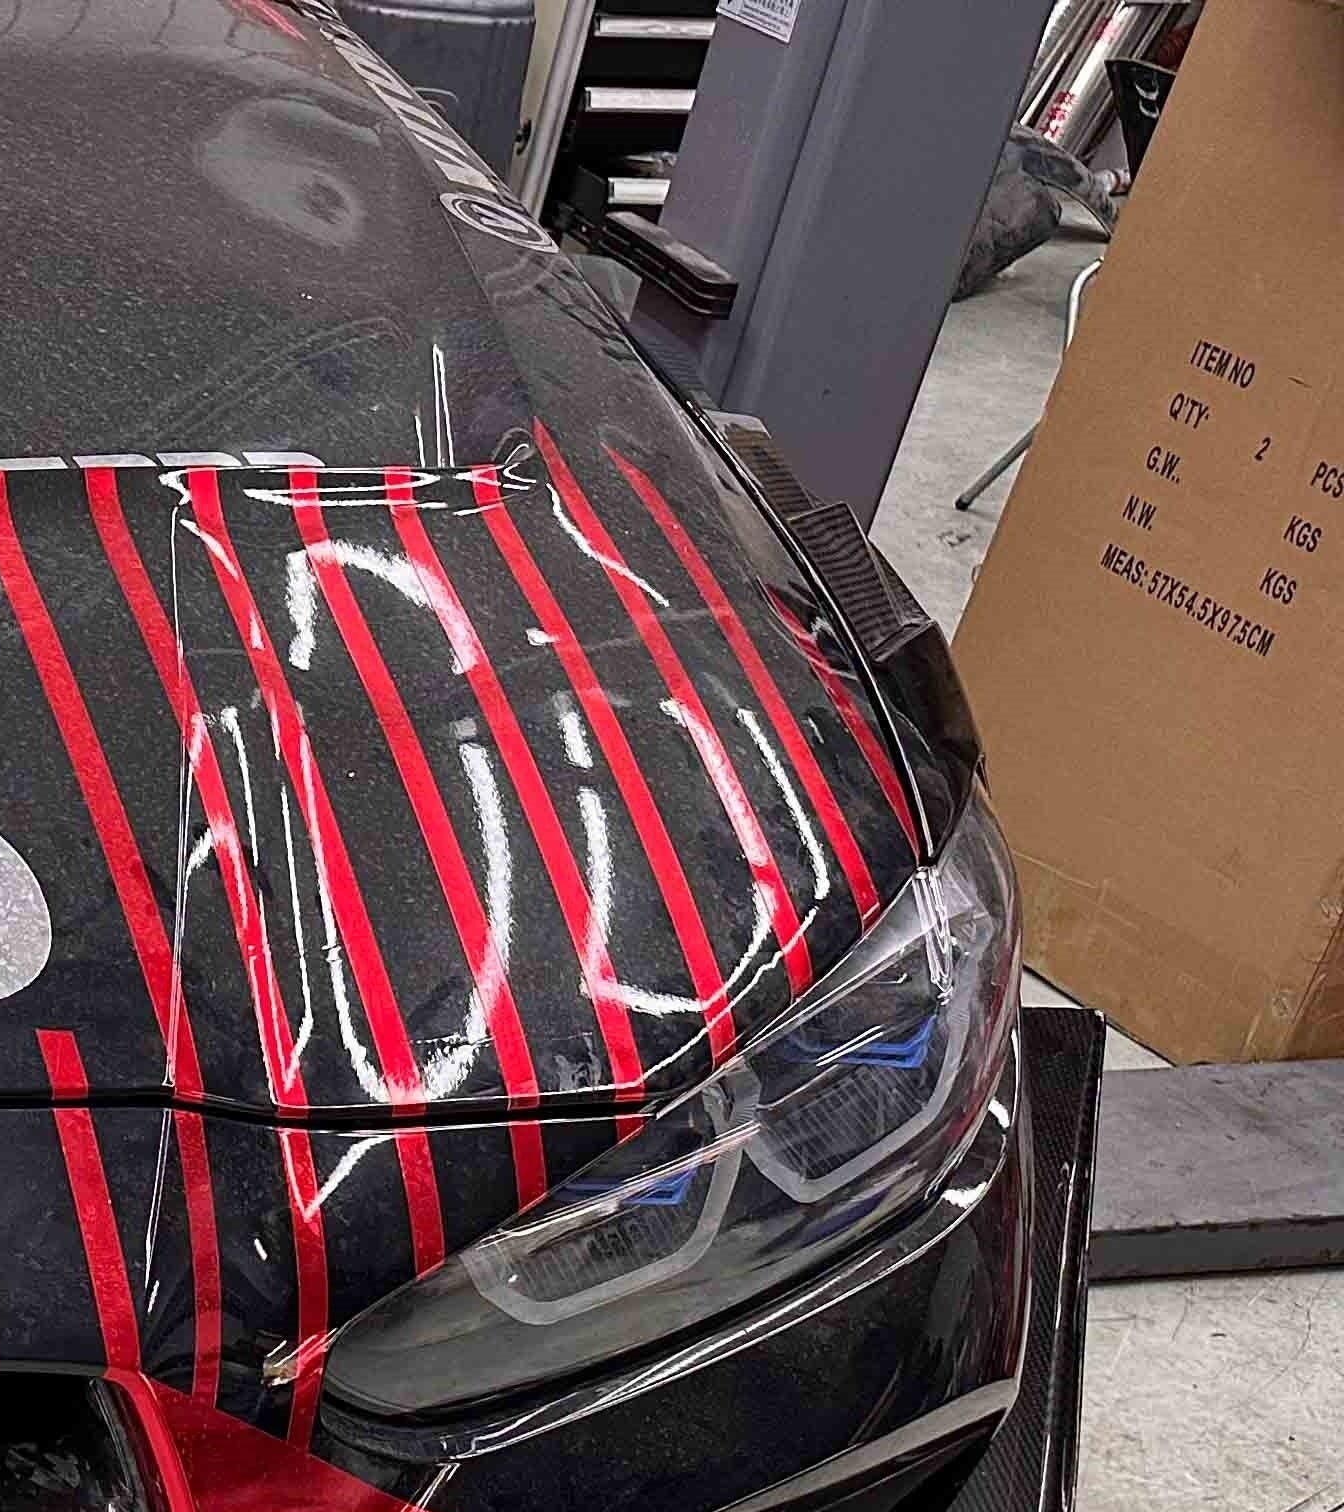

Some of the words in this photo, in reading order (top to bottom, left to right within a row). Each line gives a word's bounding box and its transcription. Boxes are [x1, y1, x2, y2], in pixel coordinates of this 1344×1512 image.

[1190, 339, 1233, 378] ITEM
[1227, 356, 1256, 388] NO
[1254, 437, 1271, 461] 2
[1310, 461, 1344, 498] PCS
[1122, 495, 1157, 531] N.W.
[1259, 567, 1297, 604] KGS
[1283, 515, 1322, 552] KGS
[1100, 544, 1149, 587] MEAS:
